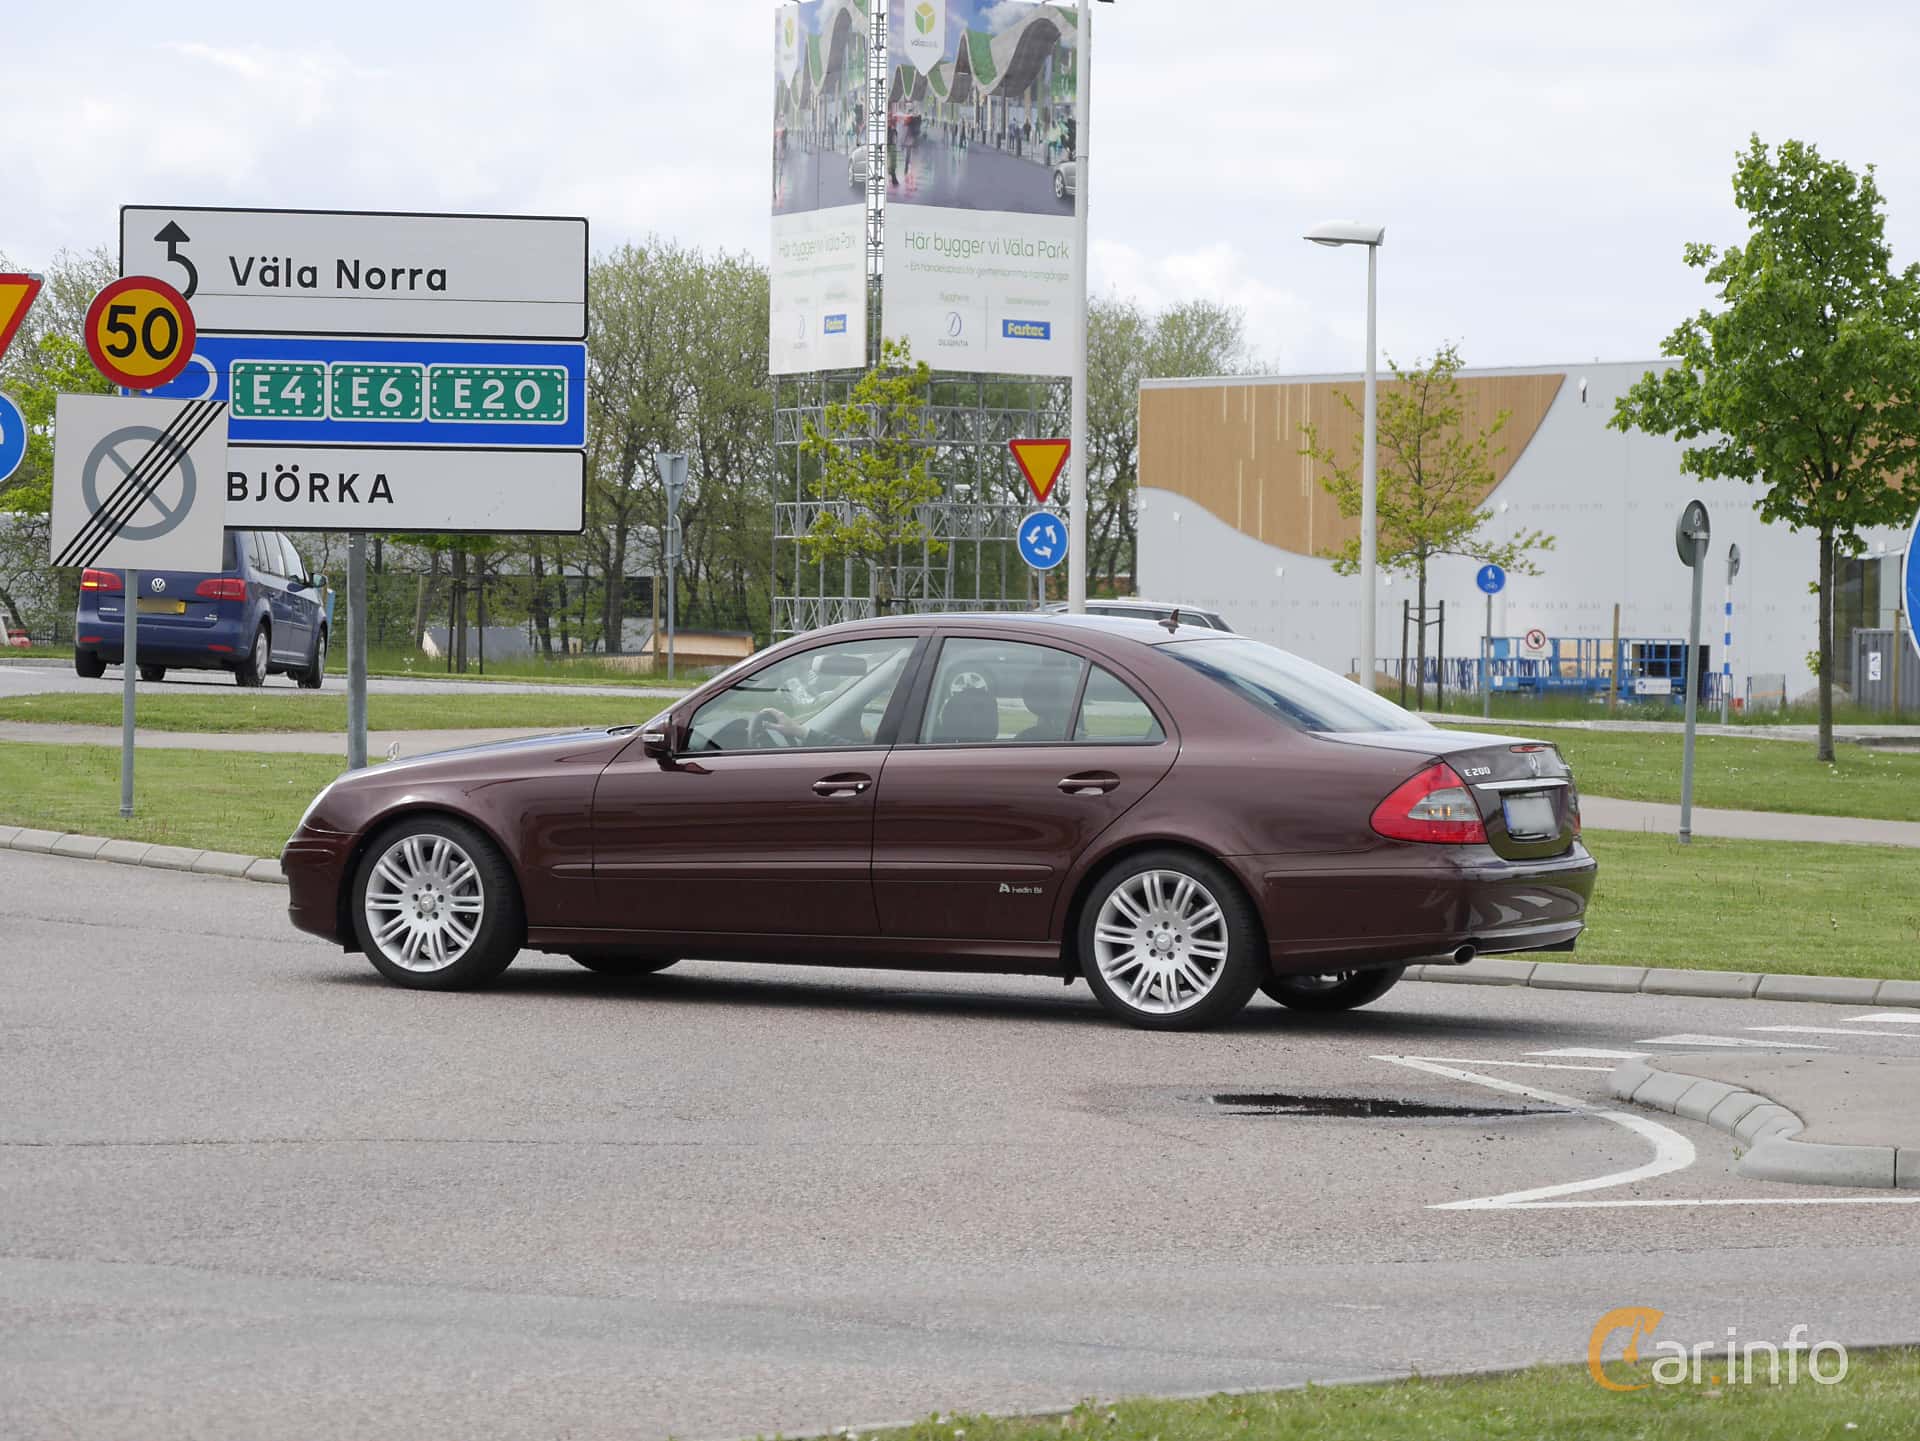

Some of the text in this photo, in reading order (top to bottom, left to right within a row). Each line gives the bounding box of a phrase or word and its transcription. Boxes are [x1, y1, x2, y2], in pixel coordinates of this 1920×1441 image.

[904, 231, 1069, 259] Här bygger vi Väla Park
[229, 256, 446, 290] Väla Norra
[106, 305, 178, 360] 50
[1007, 322, 1045, 337] Fastec
[455, 379, 540, 409] E20
[228, 464, 393, 503] BJÖRKA
